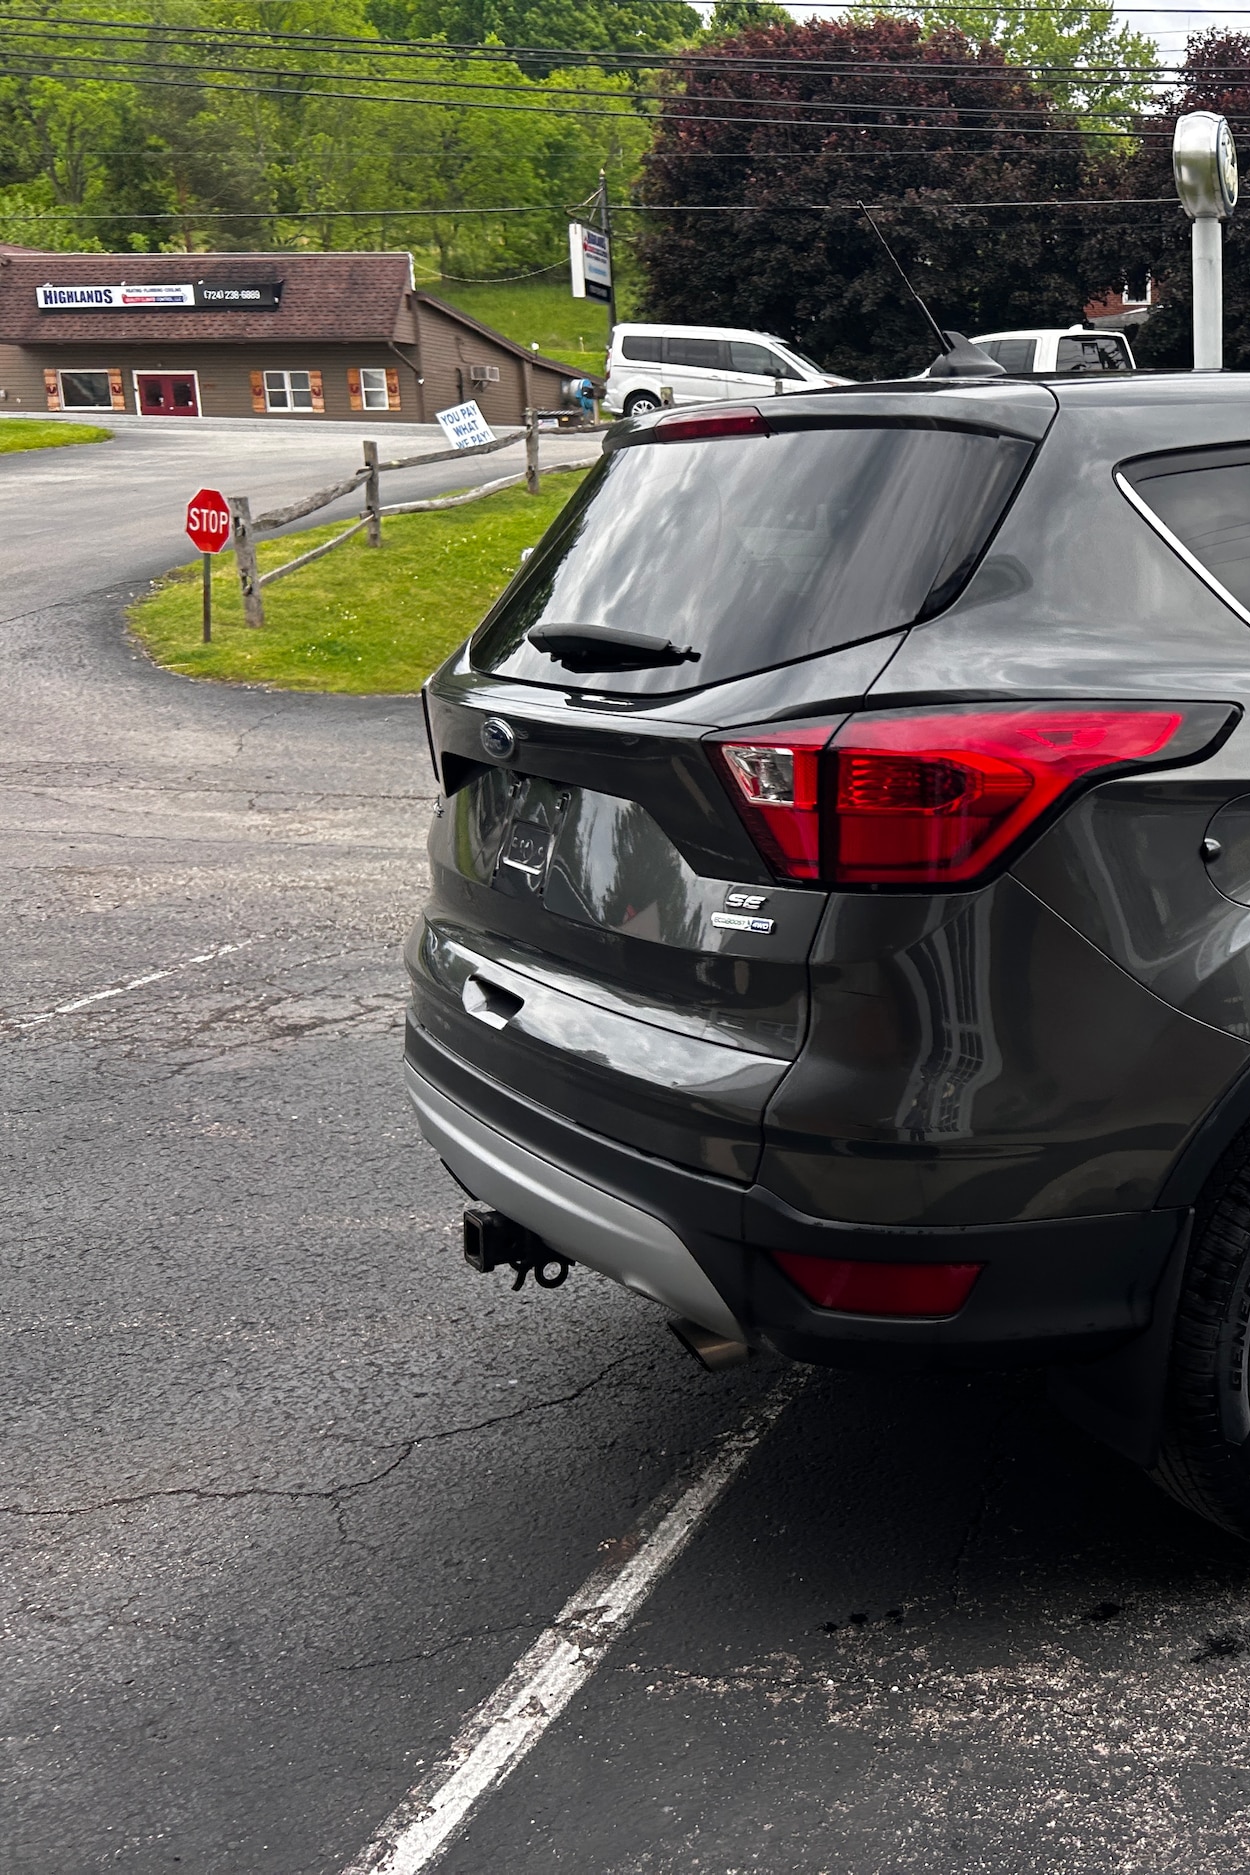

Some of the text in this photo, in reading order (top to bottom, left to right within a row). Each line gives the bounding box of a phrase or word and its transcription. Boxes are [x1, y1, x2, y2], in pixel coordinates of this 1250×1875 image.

[43, 289, 113, 304] HIGHLANDS
[204, 289, 224, 300] (724)
[440, 405, 477, 426] YOU PAY
[453, 420, 479, 437] WHAT
[456, 431, 492, 449] WE PAY!
[189, 507, 228, 534] STOP
[725, 893, 767, 910] SE
